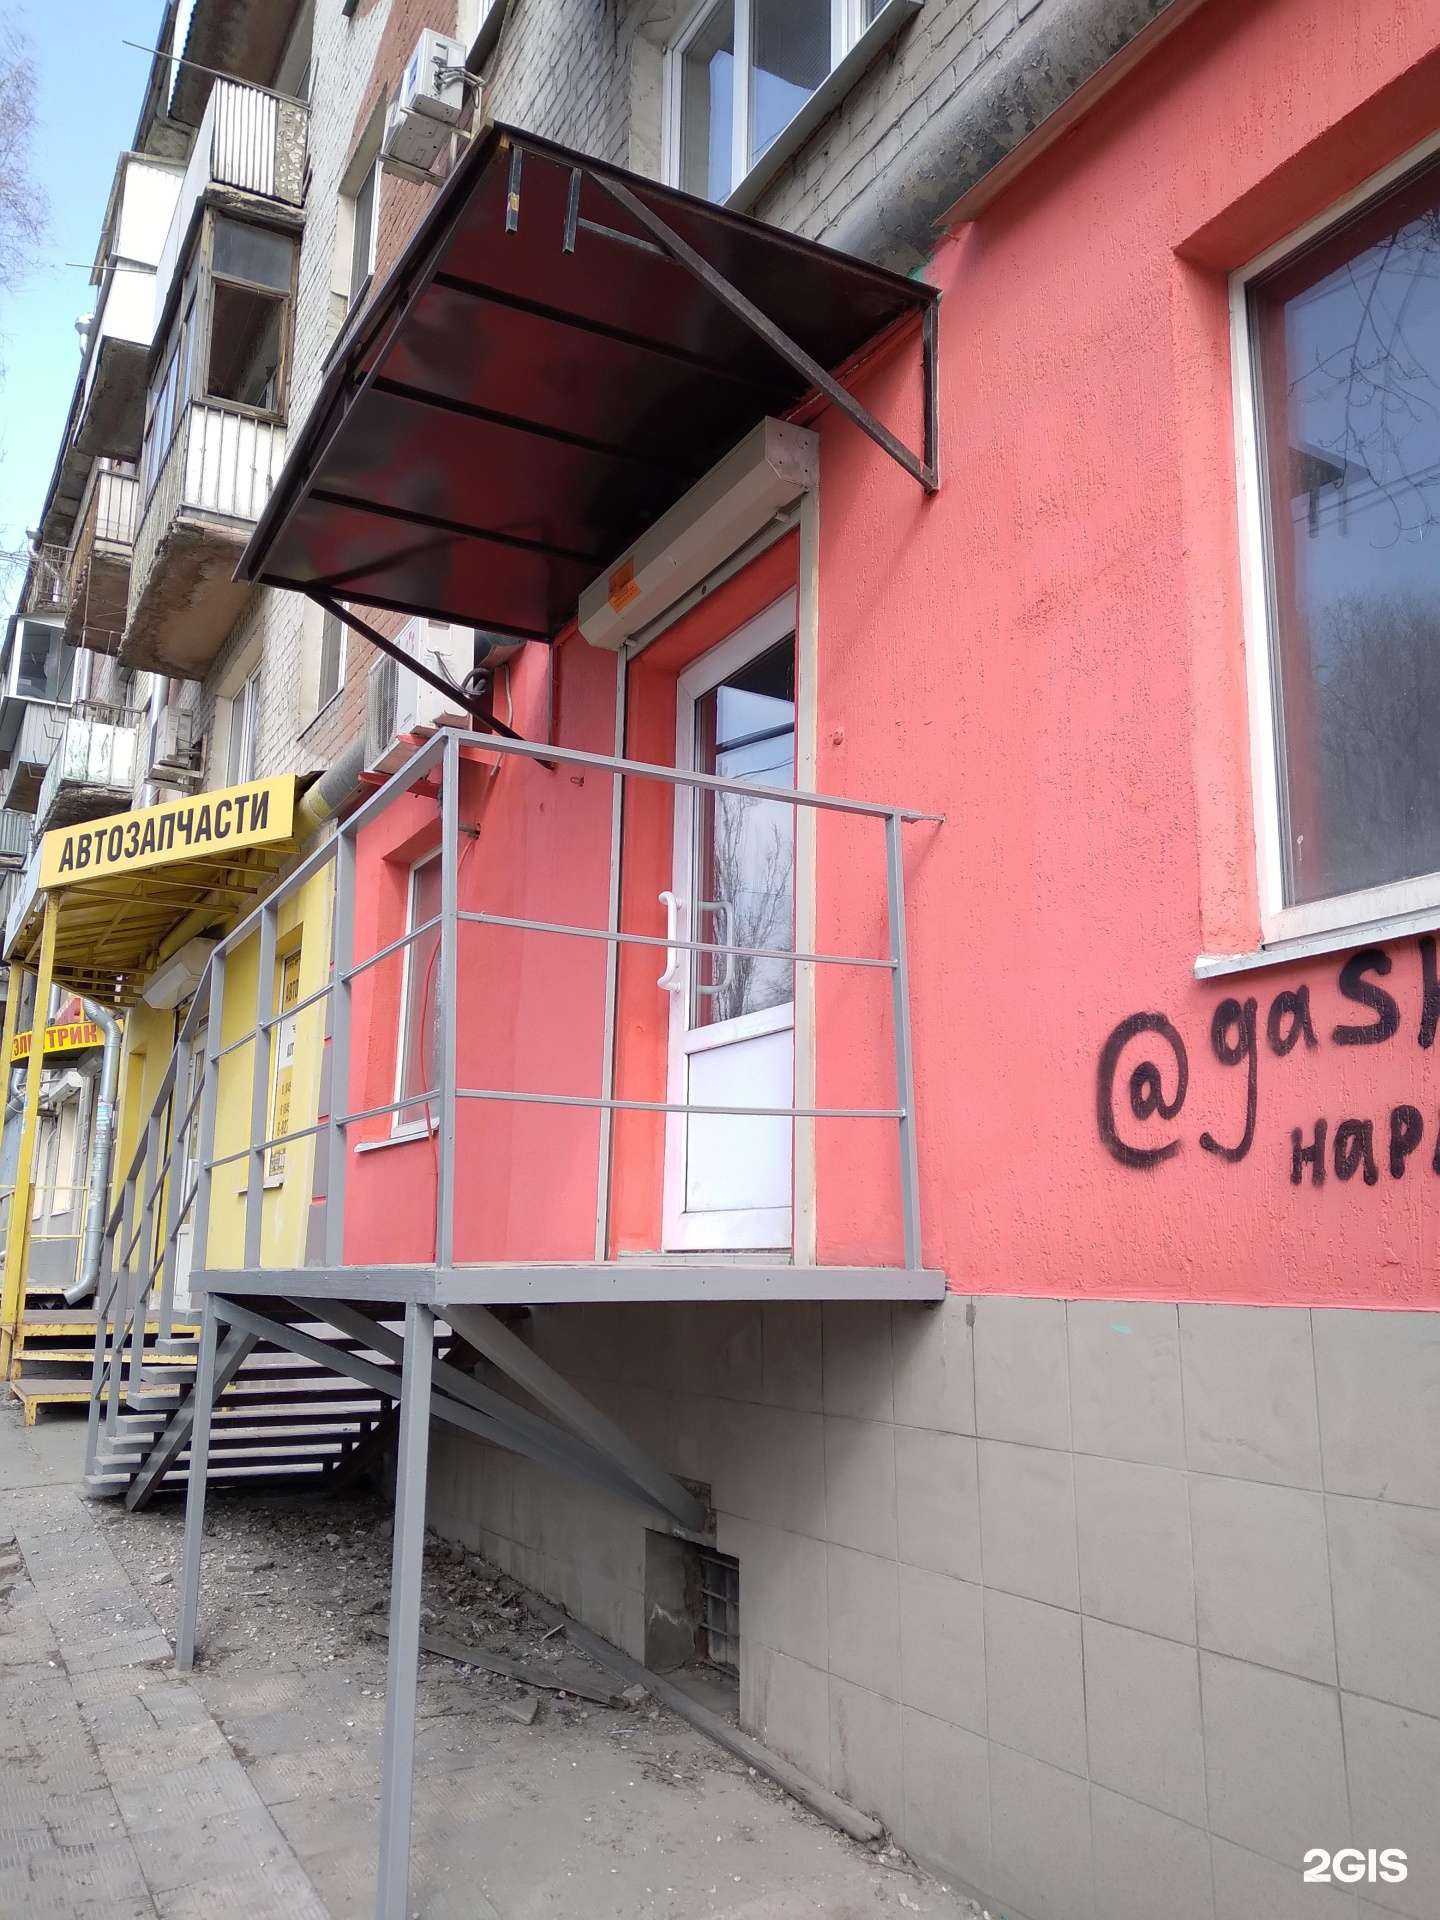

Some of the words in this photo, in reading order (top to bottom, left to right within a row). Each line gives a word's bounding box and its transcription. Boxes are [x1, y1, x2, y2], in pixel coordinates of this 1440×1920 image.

[59, 790, 270, 872] АВТОЗАПЧАСТИ
[13, 1024, 98, 1056] ЭЛТРИК
[1291, 1104, 1440, 1186] нар
